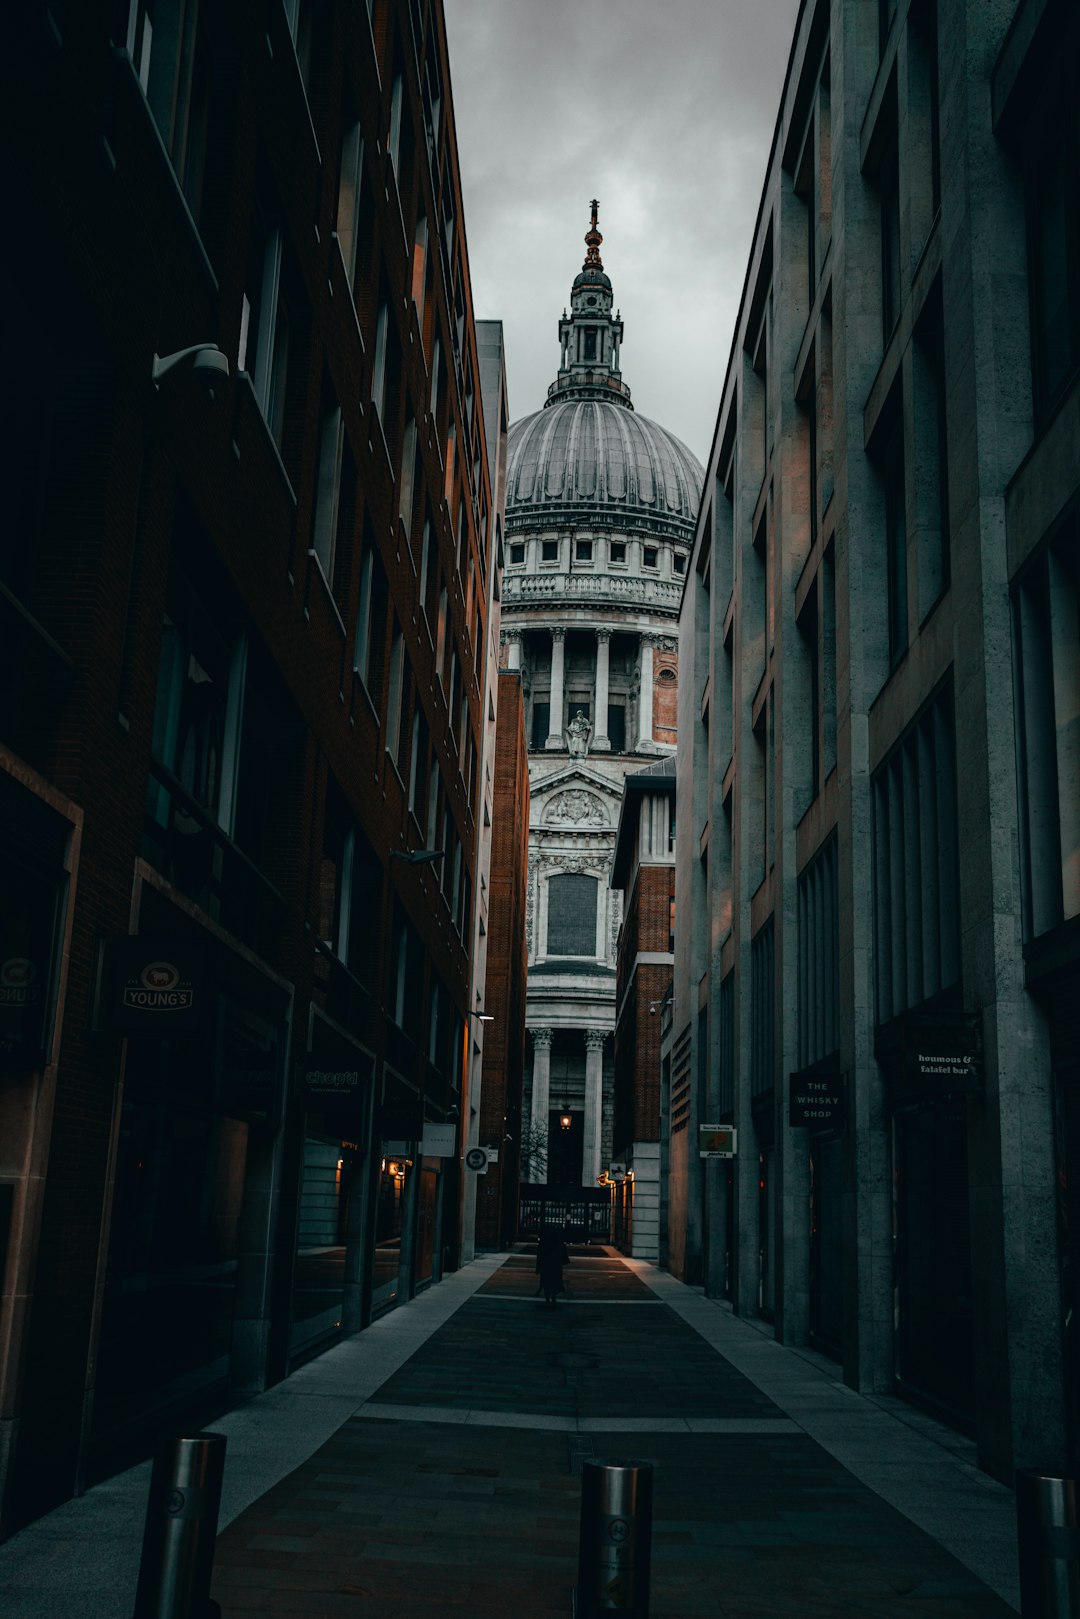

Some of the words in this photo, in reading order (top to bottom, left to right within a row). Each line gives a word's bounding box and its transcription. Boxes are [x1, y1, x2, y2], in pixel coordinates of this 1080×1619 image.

[130, 992, 187, 1006] YOUNG'S
[918, 1054, 961, 1064] houmous
[963, 1055, 972, 1064] &
[920, 1065, 951, 1074] falafel
[952, 1067, 969, 1075] bar
[807, 1083, 828, 1091] THE
[798, 1096, 839, 1105] WHISKY
[804, 1110, 832, 1119] SHOP
